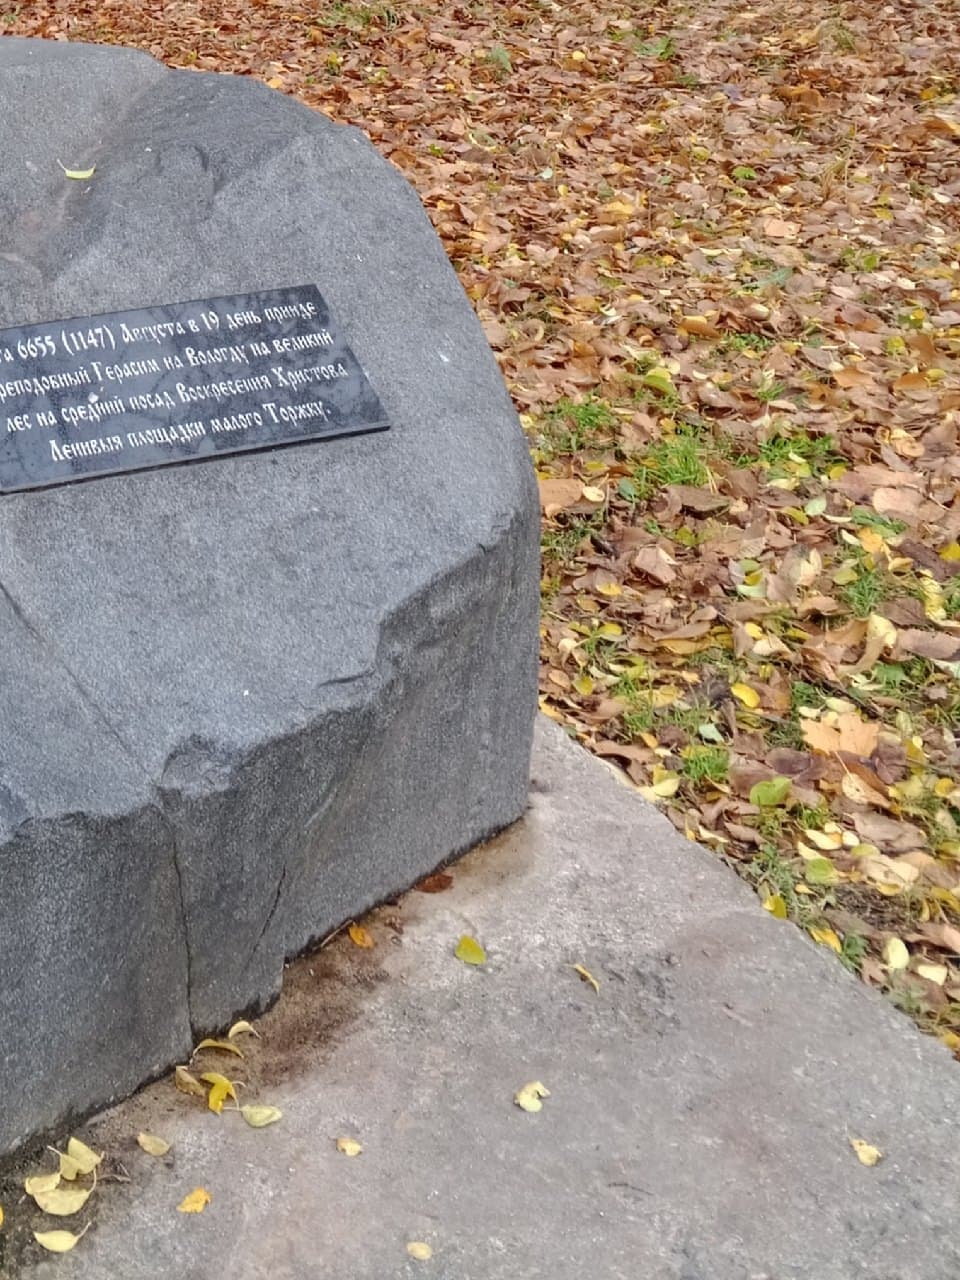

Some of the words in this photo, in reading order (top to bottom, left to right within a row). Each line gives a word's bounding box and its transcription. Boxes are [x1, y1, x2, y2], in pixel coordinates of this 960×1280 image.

[17, 335, 57, 360] 6655
[61, 325, 116, 356] (1147)
[120, 321, 186, 344] Августа
[188, 319, 200, 332] в
[201, 311, 220, 331] 19
[226, 310, 262, 331] день
[90, 358, 161, 384] Герасим
[163, 355, 184, 371] на
[185, 344, 250, 367] Вологду
[250, 341, 271, 357] на
[273, 328, 334, 354] великий
[6, 414, 32, 432] лес
[36, 410, 58, 428] на
[129, 390, 176, 411] посад
[271, 362, 349, 391] Христова
[210, 412, 263, 434] малого
